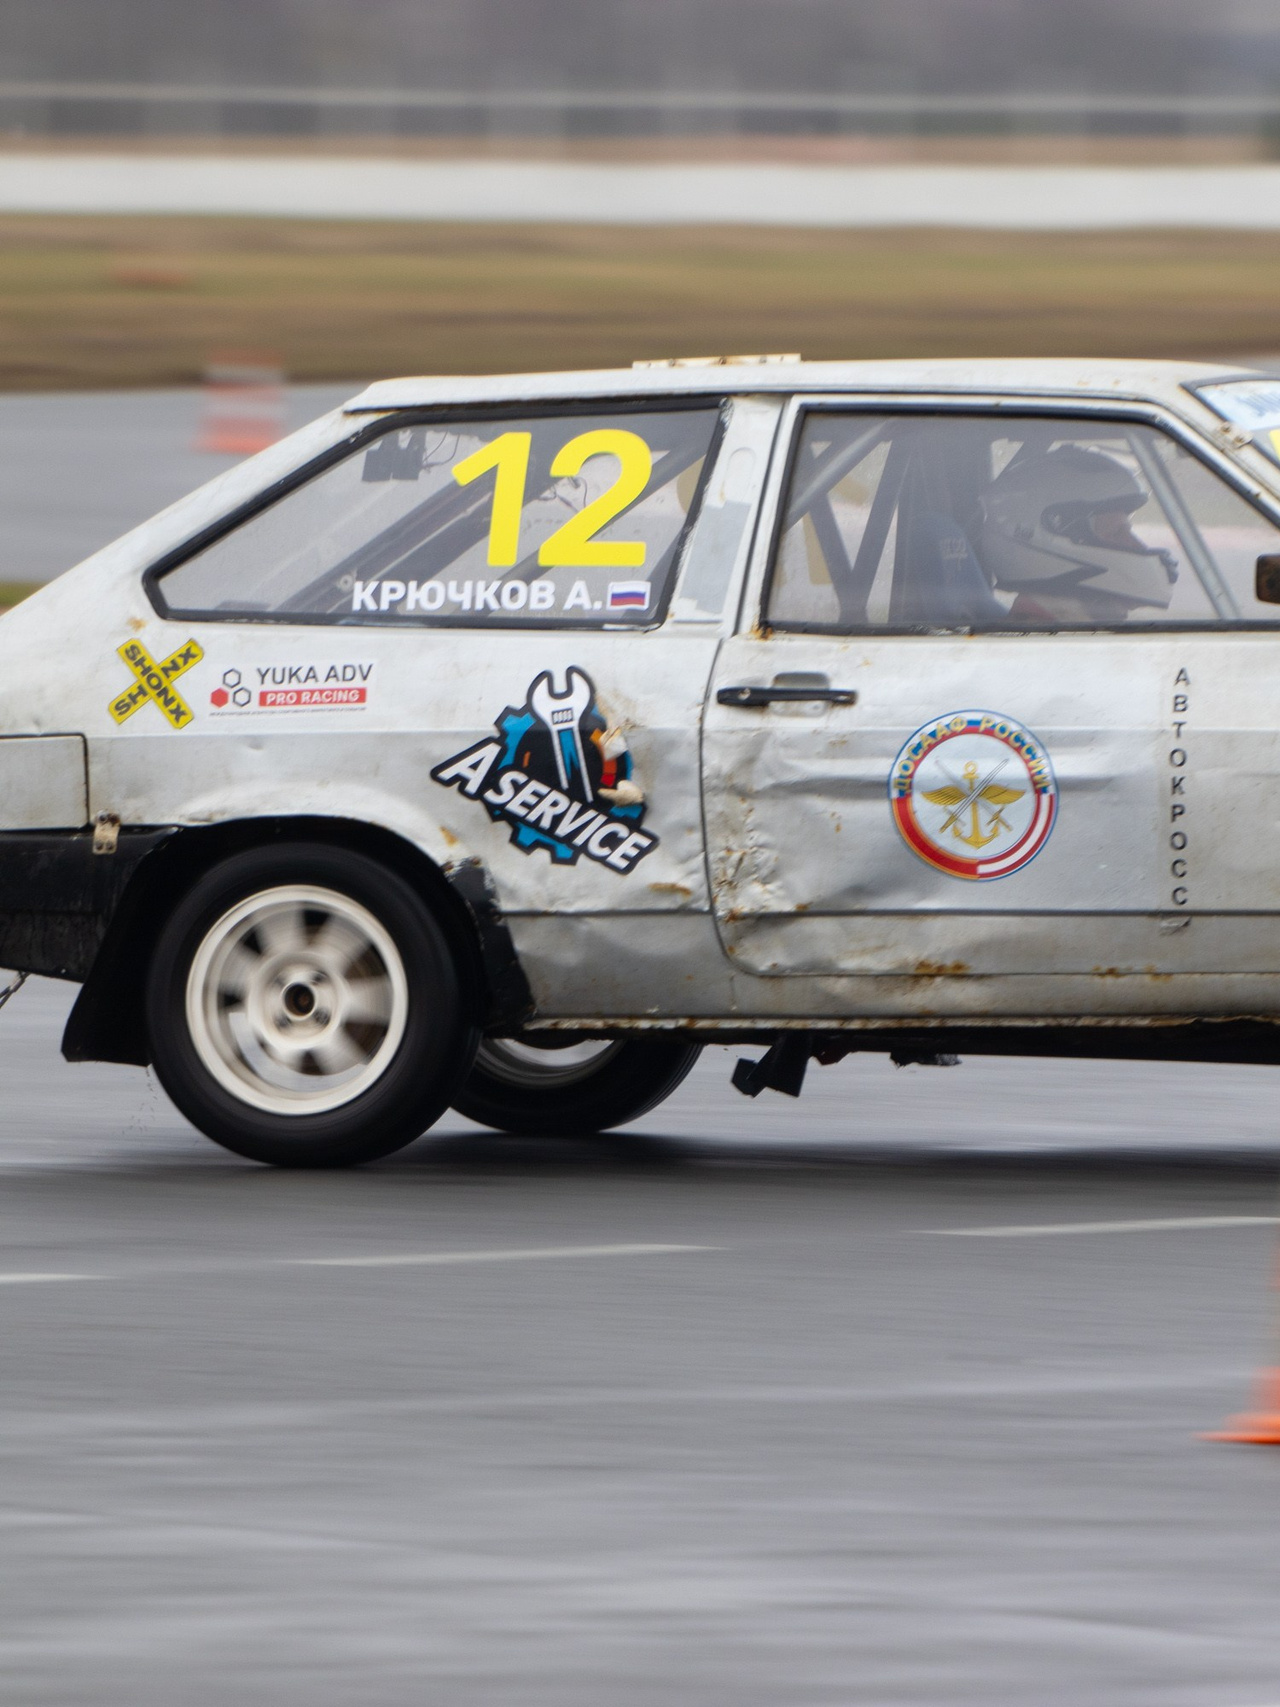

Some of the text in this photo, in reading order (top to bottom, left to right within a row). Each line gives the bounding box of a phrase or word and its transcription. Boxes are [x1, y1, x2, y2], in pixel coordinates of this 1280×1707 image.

[451, 429, 652, 567] 12
[352, 580, 603, 611] КРЮЧКОВ А.
[124, 643, 187, 724] SHONX
[256, 664, 373, 685] YUKA ADV
[266, 689, 360, 705] PRO RACING
[893, 714, 1051, 793] ДОСААФ РОССИИ
[1168, 667, 1191, 906] АВТОКРОСС
[437, 742, 653, 870] A SERVICE
